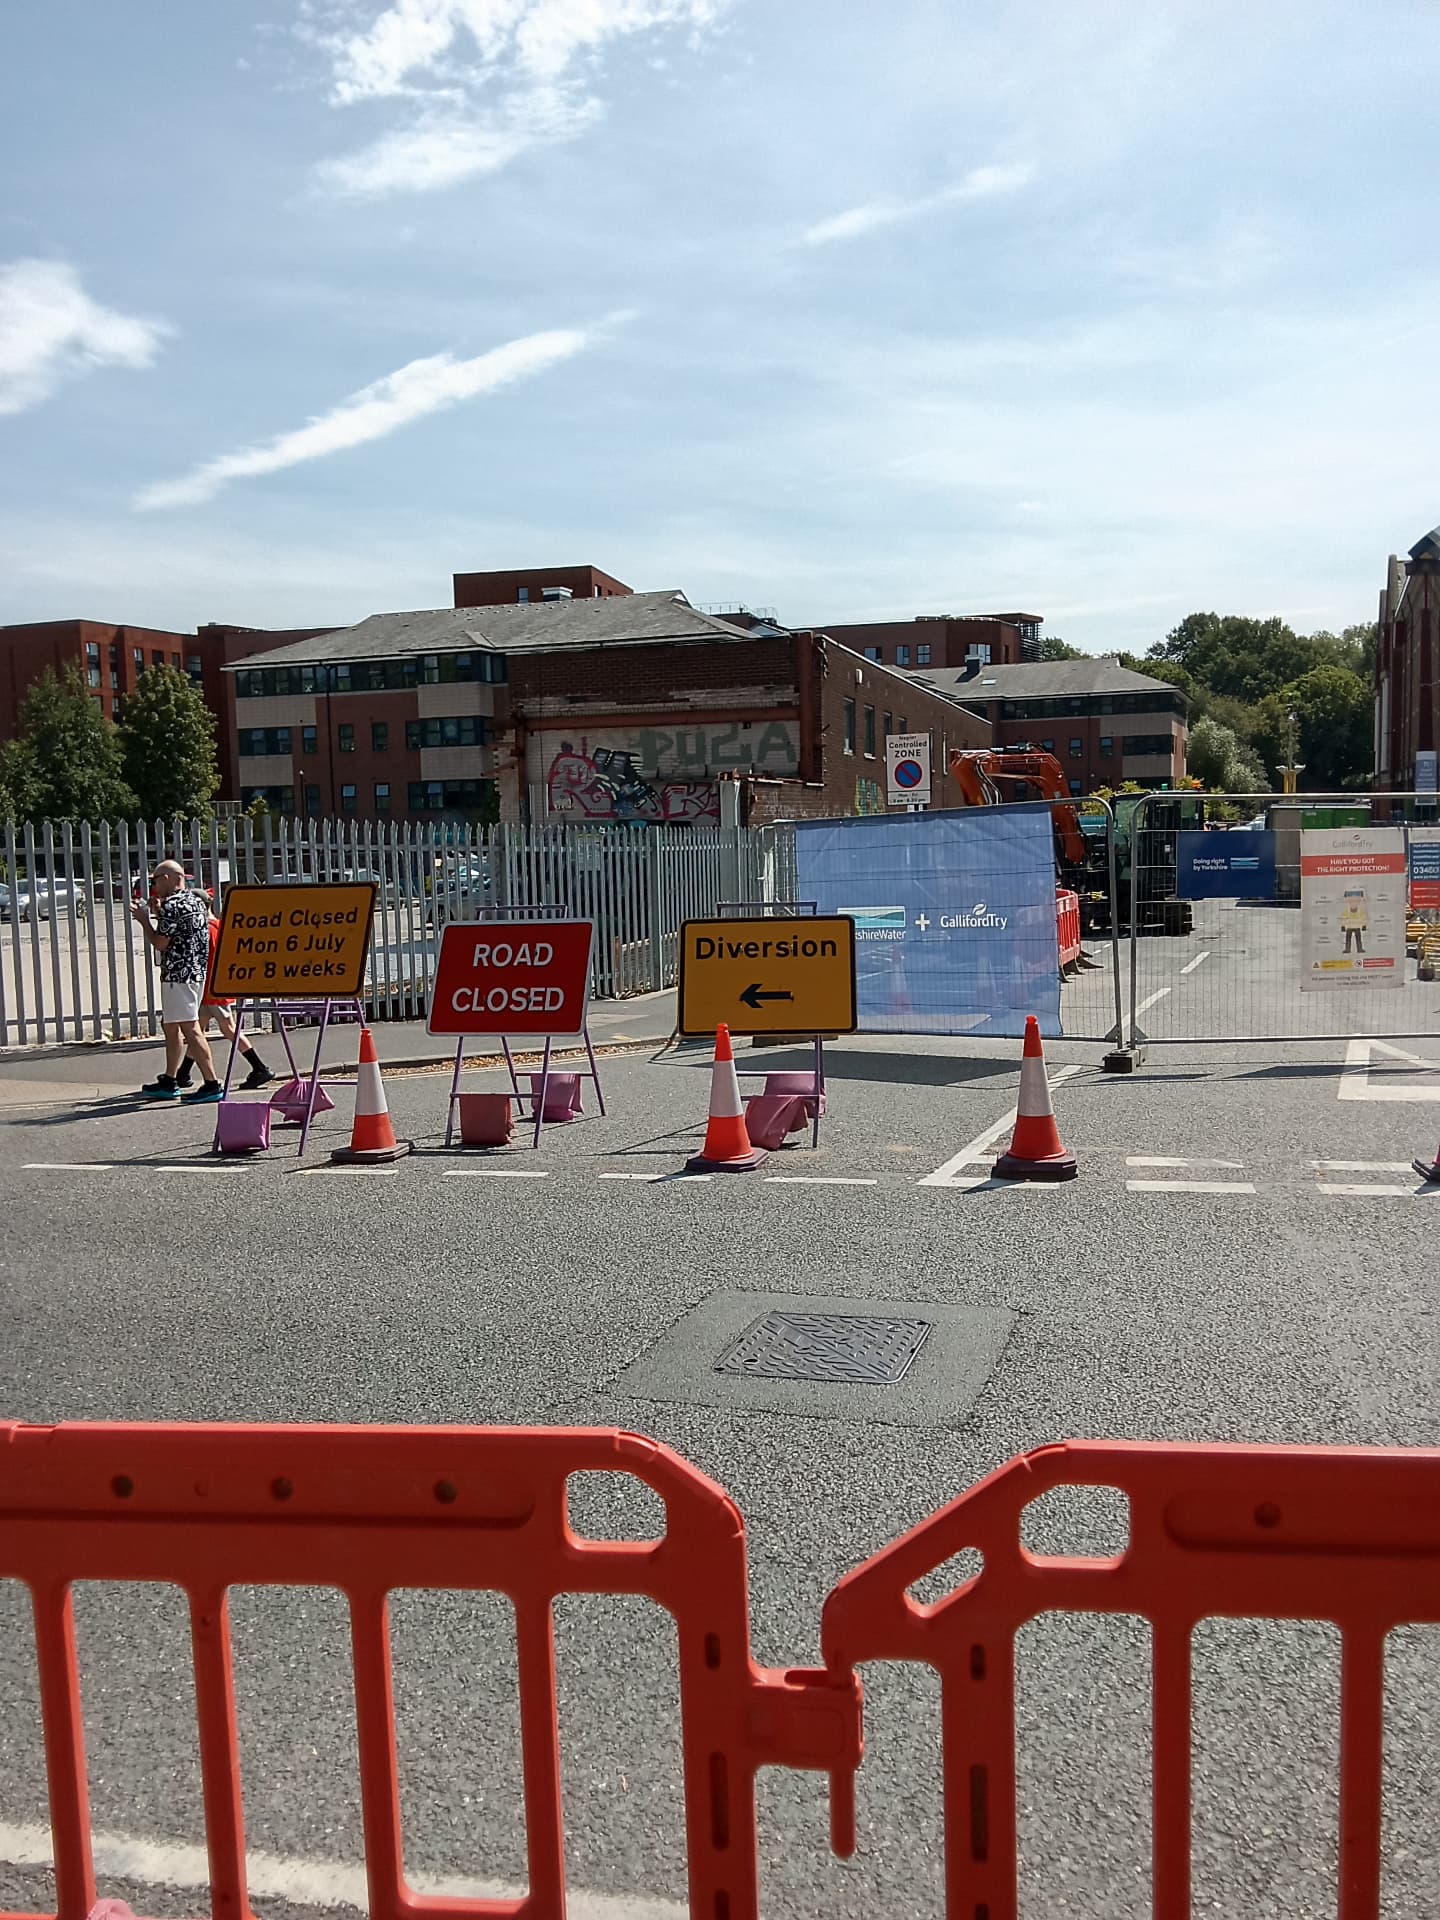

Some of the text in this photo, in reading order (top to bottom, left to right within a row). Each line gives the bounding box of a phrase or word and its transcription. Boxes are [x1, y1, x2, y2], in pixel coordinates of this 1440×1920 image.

[888, 741, 928, 749] Controlled
[894, 749, 922, 758] ZONE
[1211, 858, 1225, 866] right
[232, 907, 358, 929] Road Closed
[940, 913, 1008, 930] GallifordTry
[236, 933, 346, 954] Mon 6 July
[696, 934, 837, 960] Diversion
[473, 943, 554, 967] ROAD
[228, 960, 346, 980] for 8 weeks
[451, 987, 565, 1012] CLOSED
